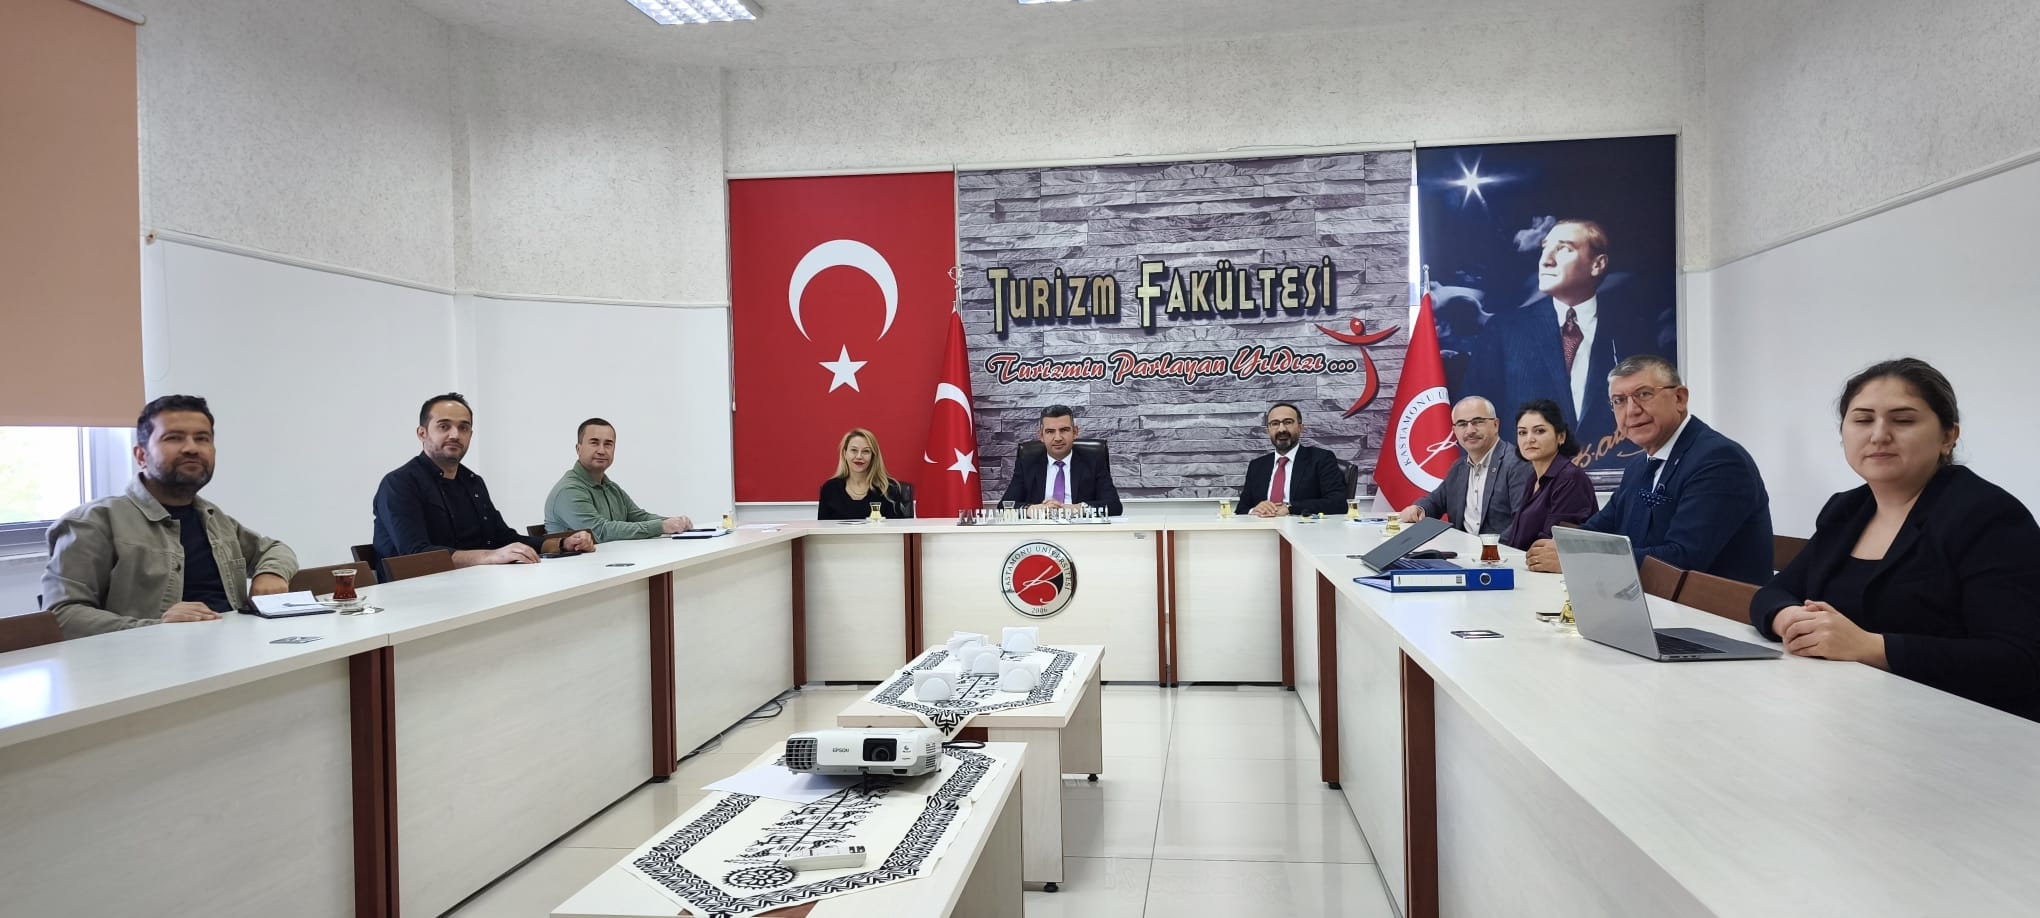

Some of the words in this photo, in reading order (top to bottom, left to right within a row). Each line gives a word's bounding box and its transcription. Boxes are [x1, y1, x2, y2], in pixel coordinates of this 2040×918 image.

[987, 353, 1104, 383] Turizmin
[1112, 349, 1226, 385] Parlayan
[1233, 346, 1325, 381] Yıldızı
[1399, 393, 1434, 467] KASTAMONU
